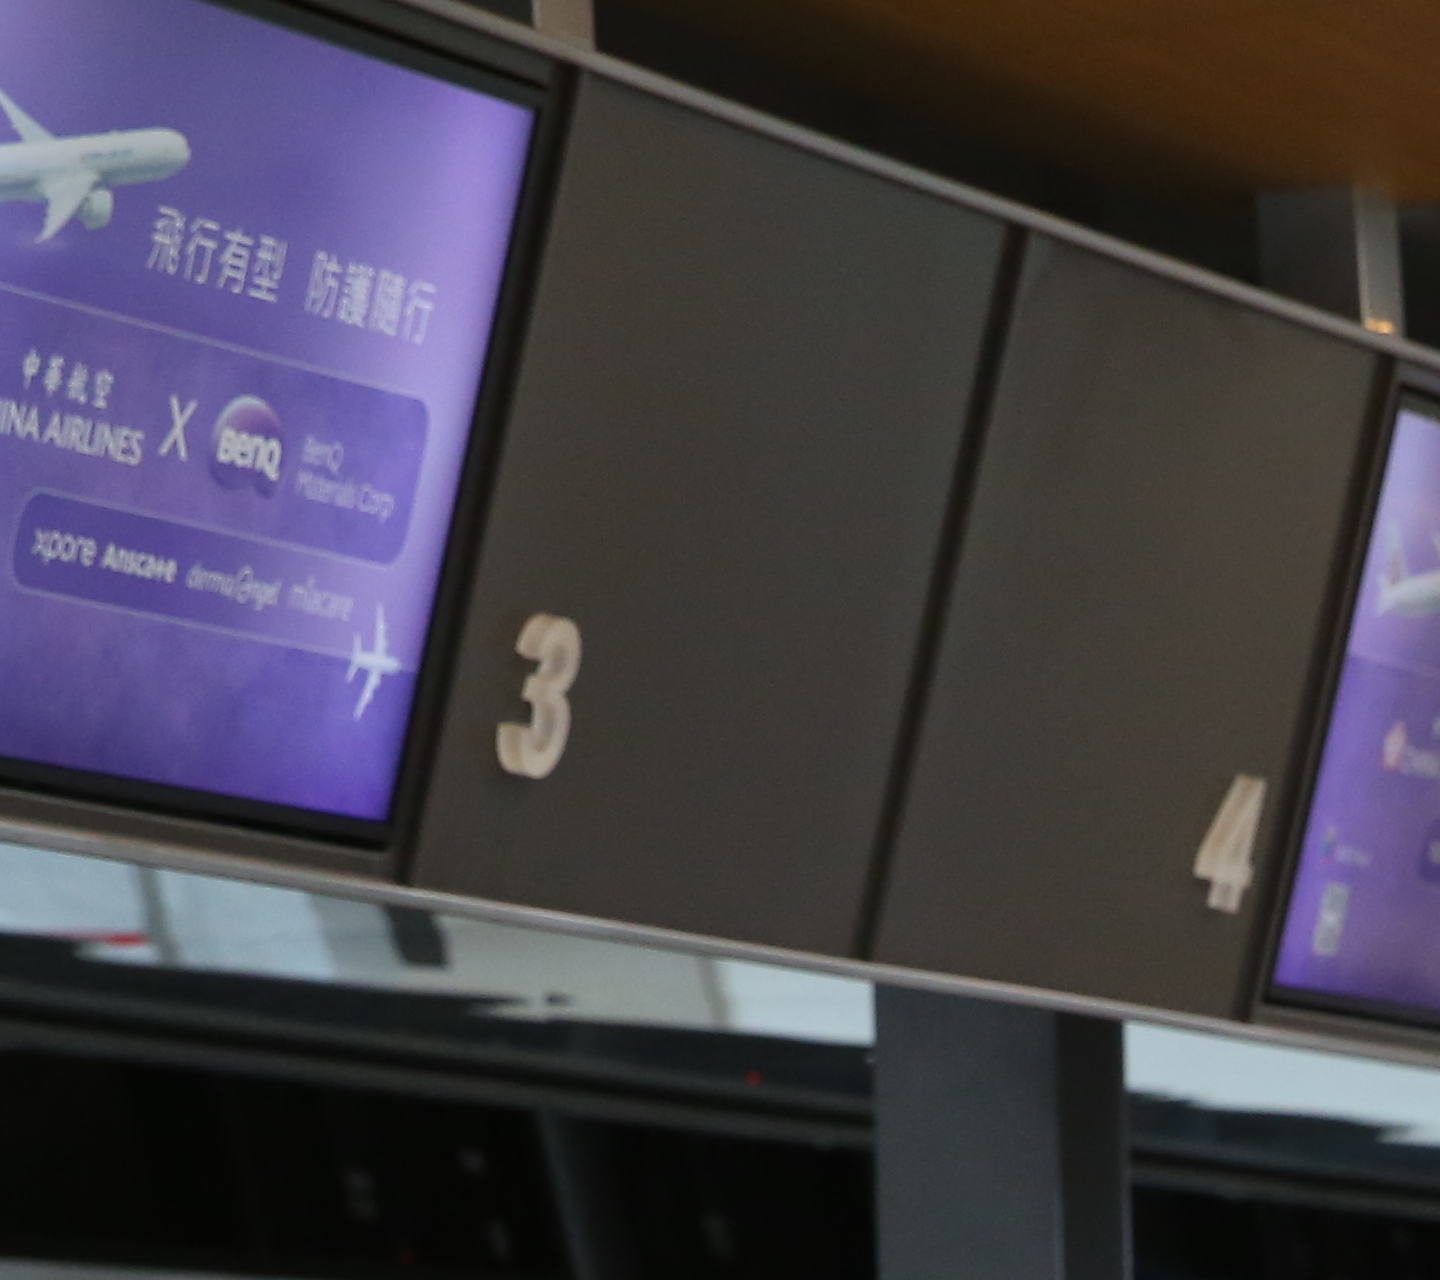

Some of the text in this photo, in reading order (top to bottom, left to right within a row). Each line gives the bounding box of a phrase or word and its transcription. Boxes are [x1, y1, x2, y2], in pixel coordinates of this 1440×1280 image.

[41, 407, 145, 467] AIRLINES
[495, 612, 582, 779] 3
[1193, 773, 1267, 914] 4
